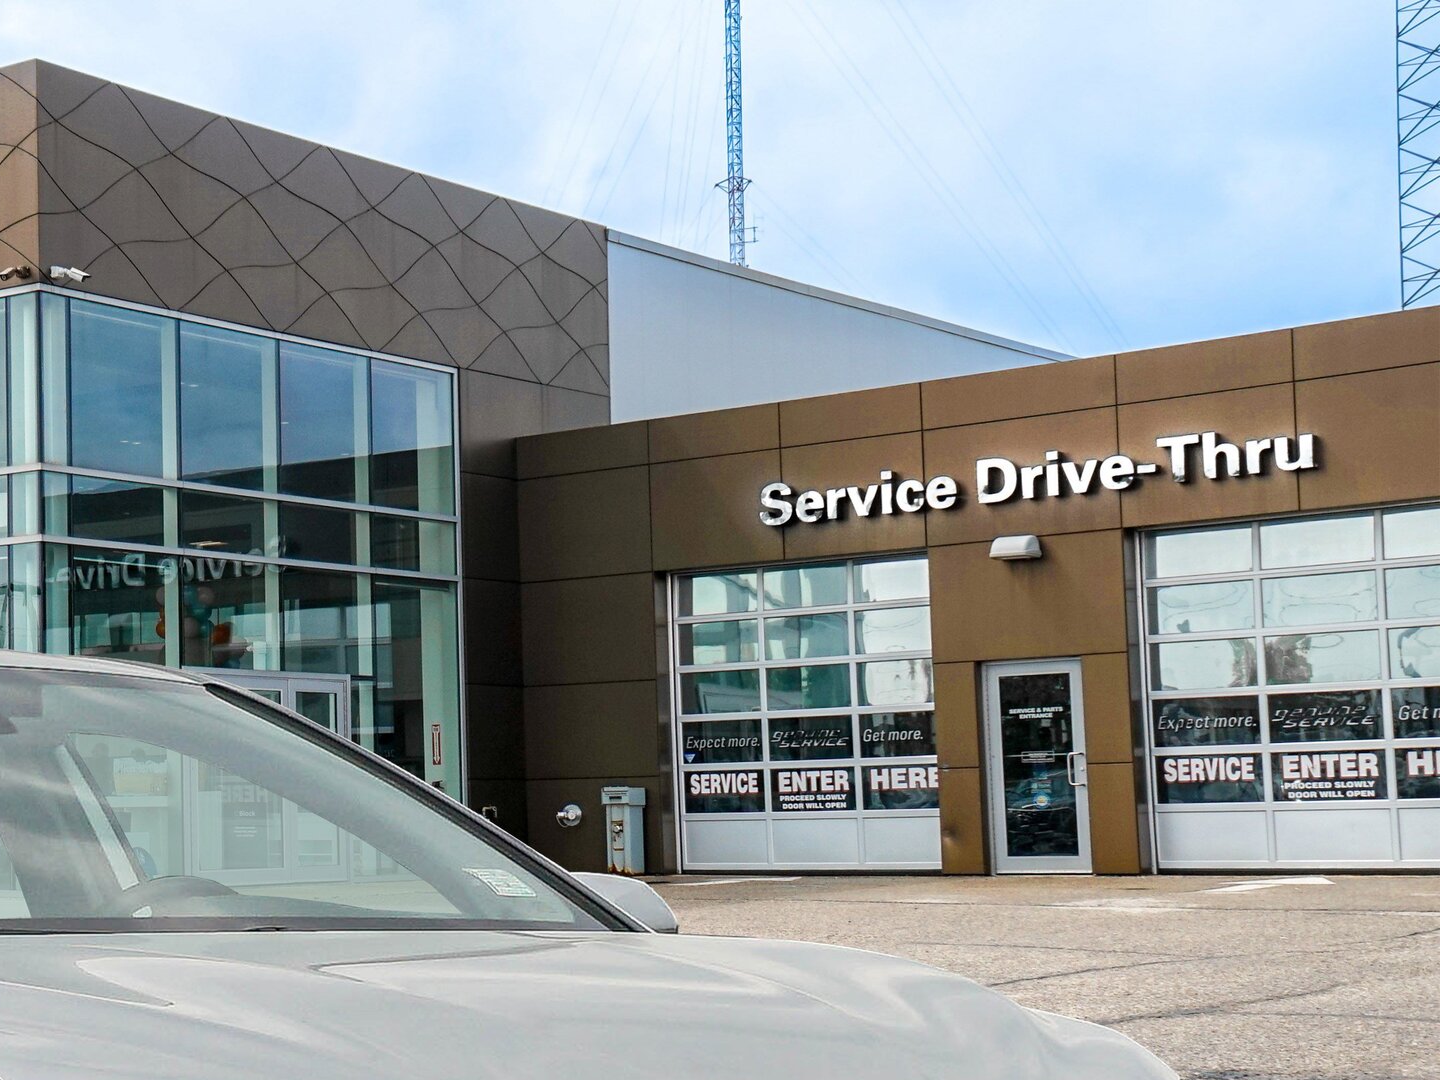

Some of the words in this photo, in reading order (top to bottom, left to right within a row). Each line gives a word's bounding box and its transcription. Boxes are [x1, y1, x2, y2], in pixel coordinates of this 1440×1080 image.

[759, 470, 959, 527] Service
[975, 430, 1317, 504] Drive-Thru
[1008, 707, 1036, 715] SERVICE
[1398, 705, 1430, 721] Get
[1157, 714, 1210, 732] Expect
[1213, 713, 1258, 728] more.
[1282, 714, 1376, 728] SERVICE
[686, 735, 725, 750] Expect
[727, 735, 761, 748] more.
[778, 736, 850, 748] SERVICE
[863, 728, 885, 743] Get
[888, 729, 924, 742] more.
[1163, 756, 1256, 783] SERVICE
[1281, 752, 1379, 780] ENTER
[689, 772, 760, 796] SERVICE
[777, 769, 851, 794] ENTER
[869, 766, 939, 791] HERE
[1283, 782, 1333, 791] PROCEED
[1334, 780, 1375, 790] SLOWLY
[816, 793, 847, 802] SLOWLY
[1288, 790, 1318, 799] DOOR
[1319, 790, 1344, 798] WILL
[1346, 789, 1375, 798] OPEN
[782, 803, 804, 811] DOOR
[805, 802, 824, 810] WILL
[825, 801, 847, 810] OPEN
